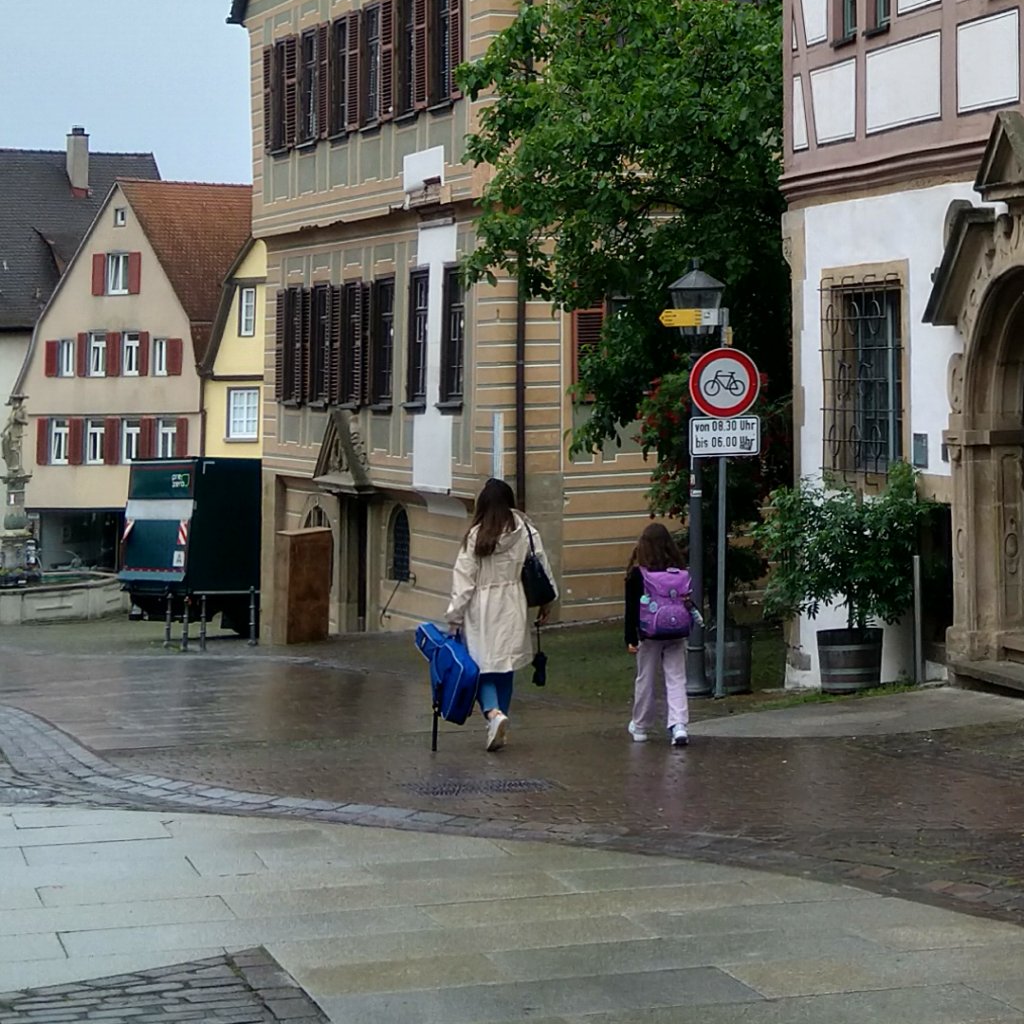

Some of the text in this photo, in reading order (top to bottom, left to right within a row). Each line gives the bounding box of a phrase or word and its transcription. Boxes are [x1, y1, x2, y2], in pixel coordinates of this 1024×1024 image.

[695, 419, 756, 432] von 08.30 Uhr
[695, 435, 756, 448] bis 06.00 Uhr
